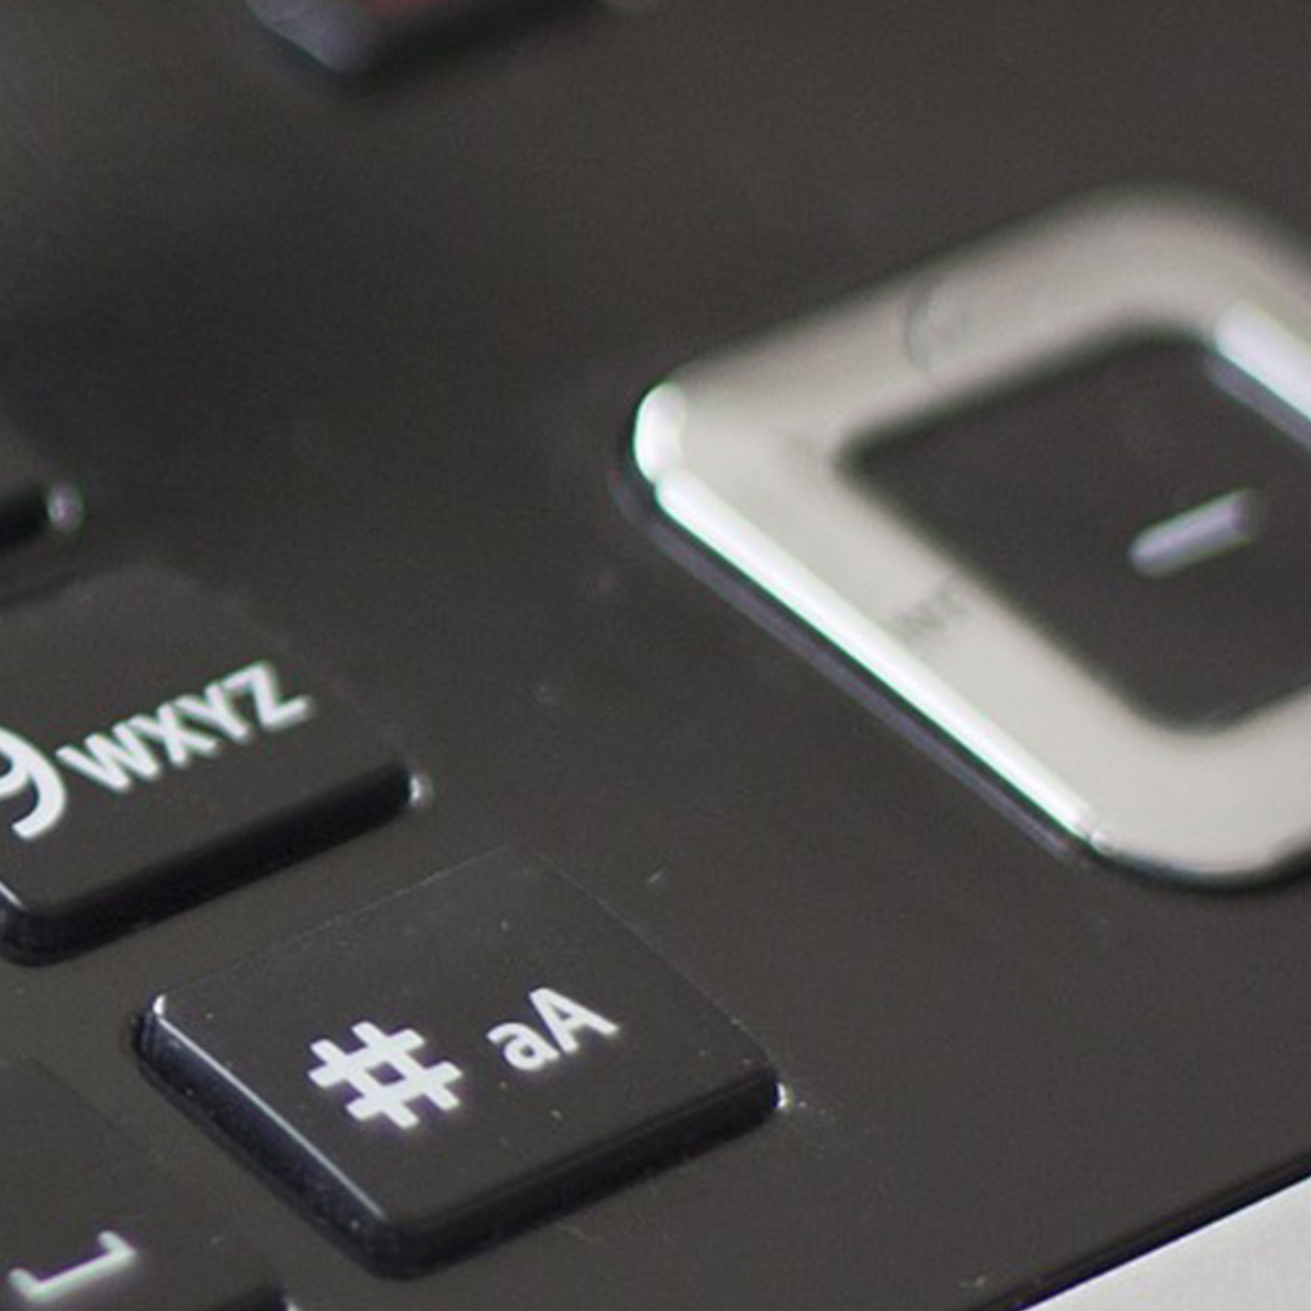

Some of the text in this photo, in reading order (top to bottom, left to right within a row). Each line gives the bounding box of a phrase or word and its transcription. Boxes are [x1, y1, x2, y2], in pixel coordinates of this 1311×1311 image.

[55, 662, 310, 793] WXYZ
[307, 986, 620, 1131] # aA
